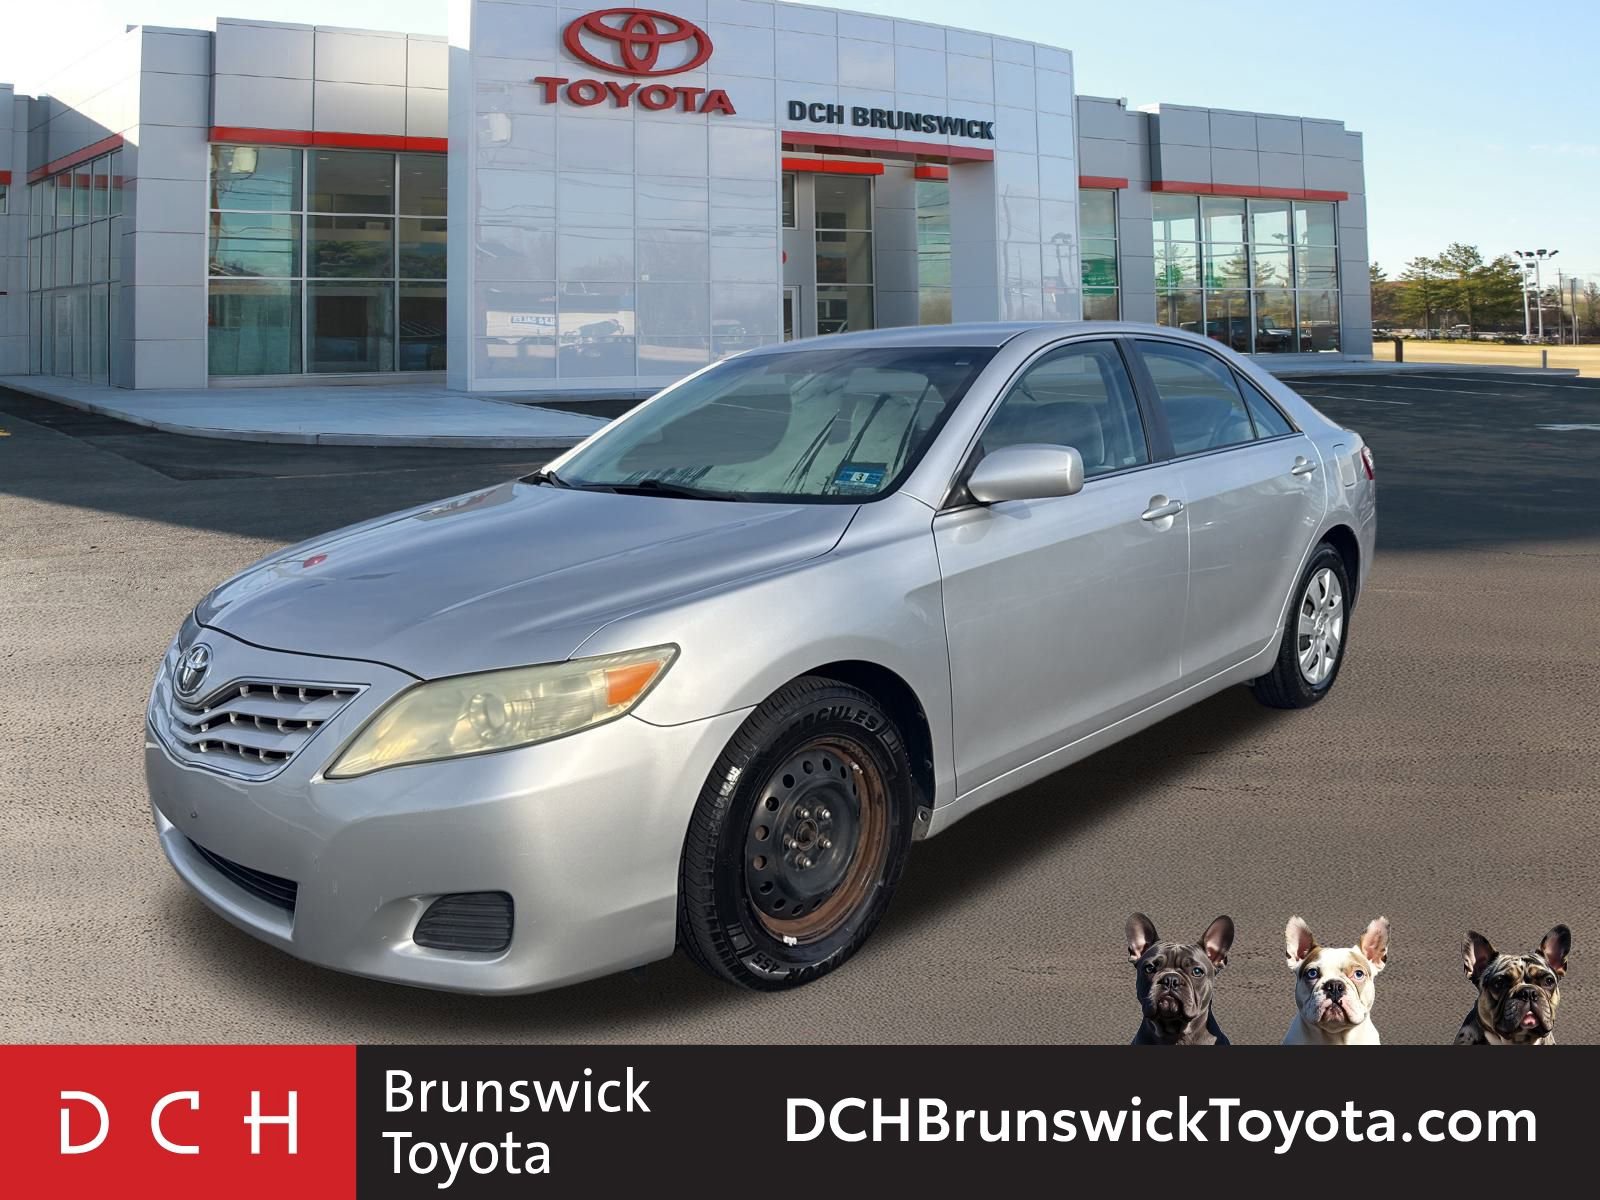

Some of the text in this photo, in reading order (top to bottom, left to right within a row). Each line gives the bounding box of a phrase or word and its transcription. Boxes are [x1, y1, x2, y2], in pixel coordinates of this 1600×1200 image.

[534, 76, 737, 115] TOYOTA
[787, 100, 995, 140] DCH BRUNSWICK
